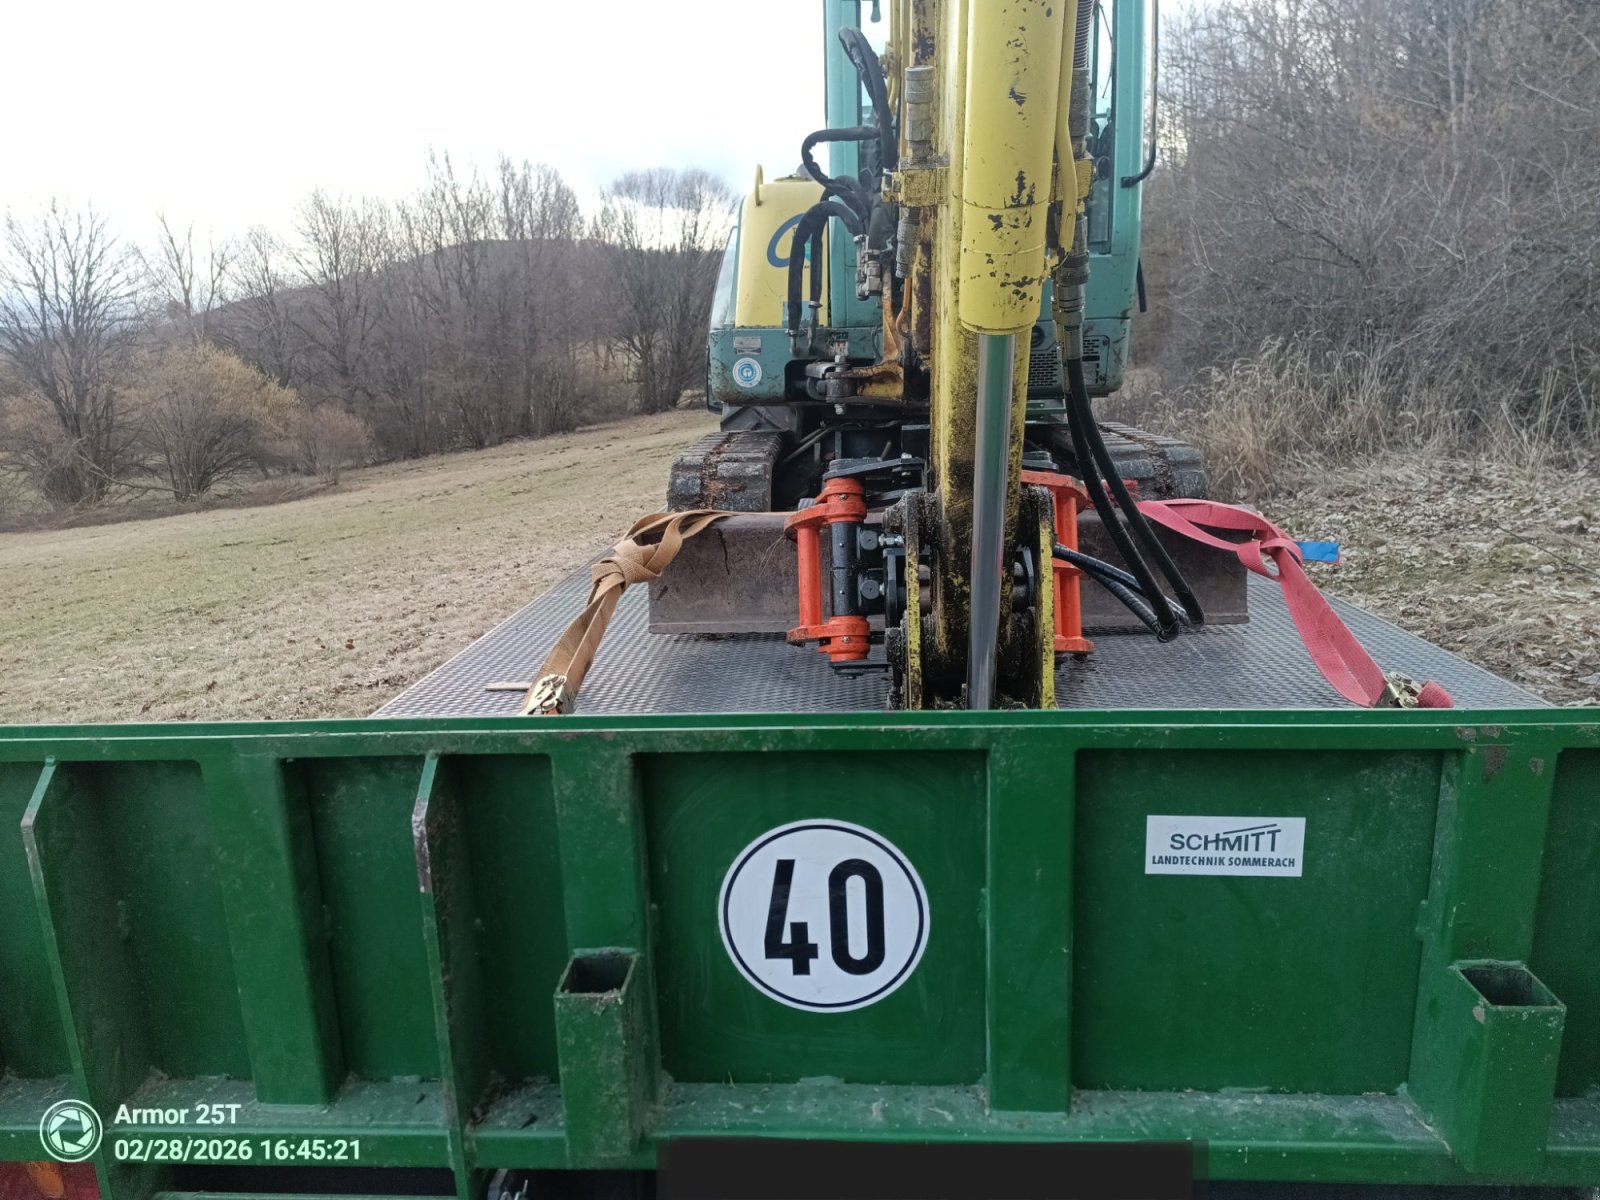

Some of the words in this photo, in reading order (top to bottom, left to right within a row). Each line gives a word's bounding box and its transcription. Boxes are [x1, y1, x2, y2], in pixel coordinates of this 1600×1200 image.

[1170, 827, 1281, 852] SCHMITT
[1152, 855, 1225, 866] LANDTECHNIK
[1228, 857, 1295, 867] SOMMERACH
[764, 858, 886, 976] 40
